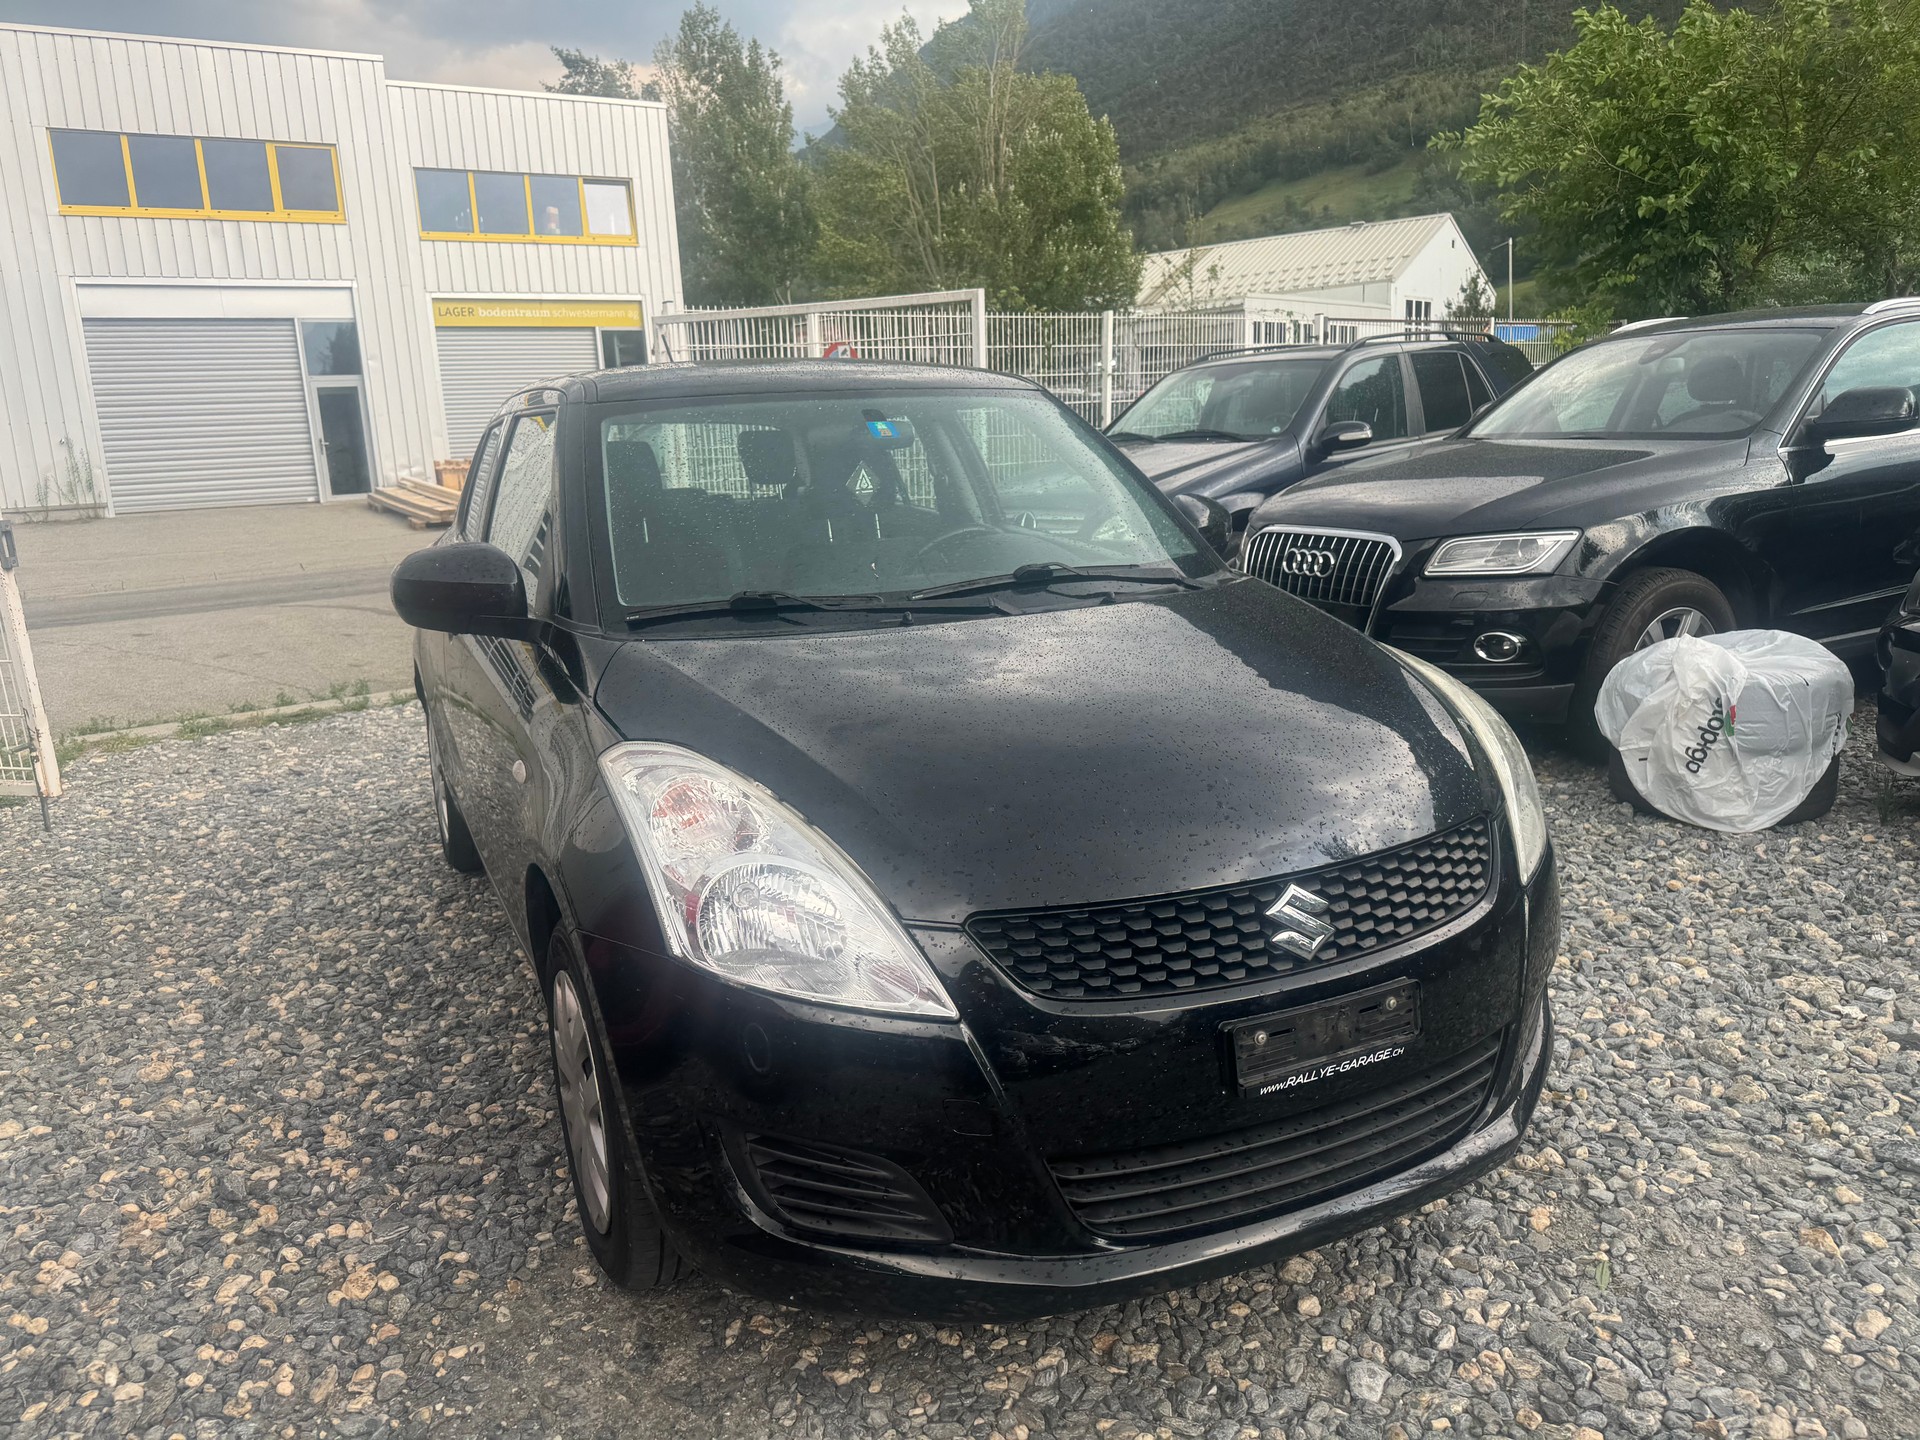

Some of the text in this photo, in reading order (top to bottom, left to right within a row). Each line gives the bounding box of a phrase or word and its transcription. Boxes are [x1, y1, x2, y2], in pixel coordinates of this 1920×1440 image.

[438, 306, 475, 317] LAGER
[478, 307, 551, 318] bodentraum
[552, 307, 626, 318] schwestermann
[1259, 1047, 1405, 1096] www.RALLYE-GARAGE.CH
